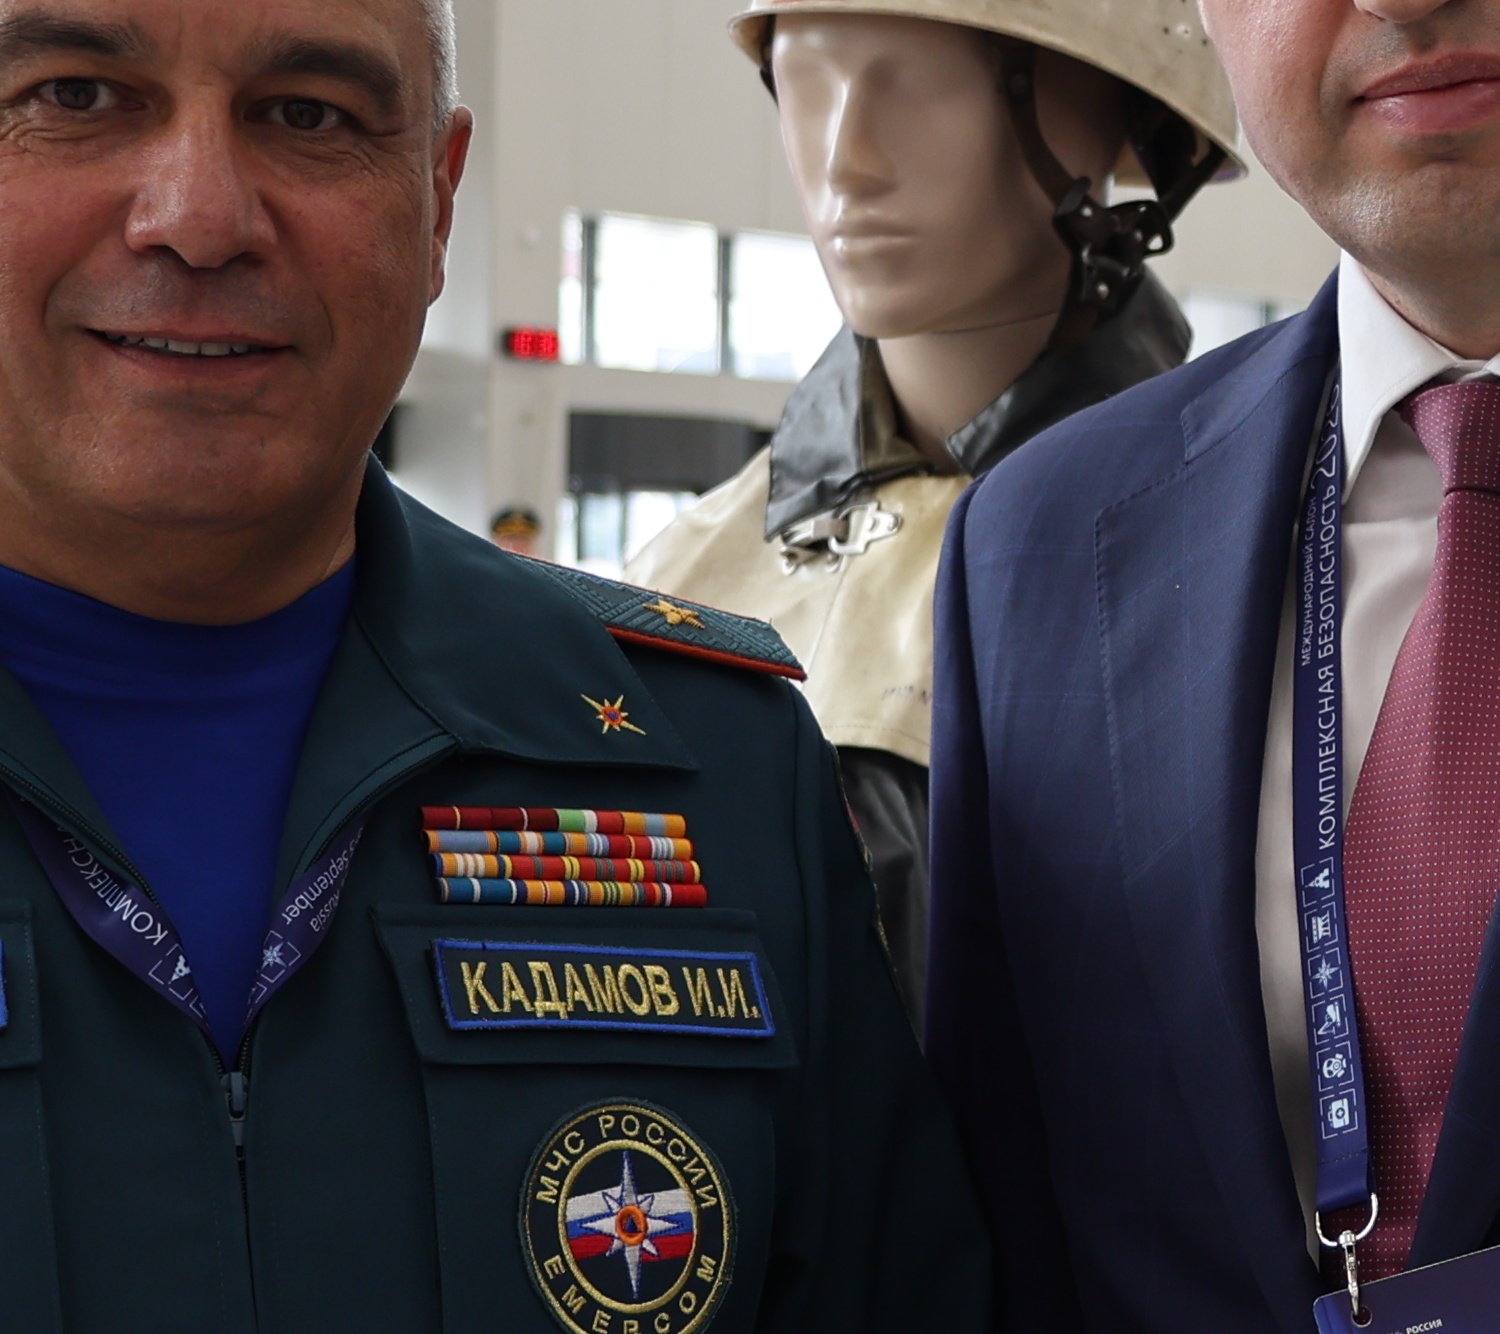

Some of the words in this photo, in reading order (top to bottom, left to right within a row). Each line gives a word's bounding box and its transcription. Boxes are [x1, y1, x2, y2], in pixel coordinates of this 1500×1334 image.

[1304, 496, 1317, 541] САЛОН
[1302, 542, 1315, 667] МЕЖДУНАРОДНЫЙ
[1318, 484, 1337, 660] БЕЗОПАСНОСТЬ
[1317, 663, 1336, 850] КОМПЛЕКСНАЯ
[282, 851, 350, 926] September
[460, 961, 680, 1020] КАДАМОВ
[685, 967, 762, 1020] И.И.
[535, 1130, 586, 1206] МЧС
[598, 1114, 718, 1210] РОССИИ
